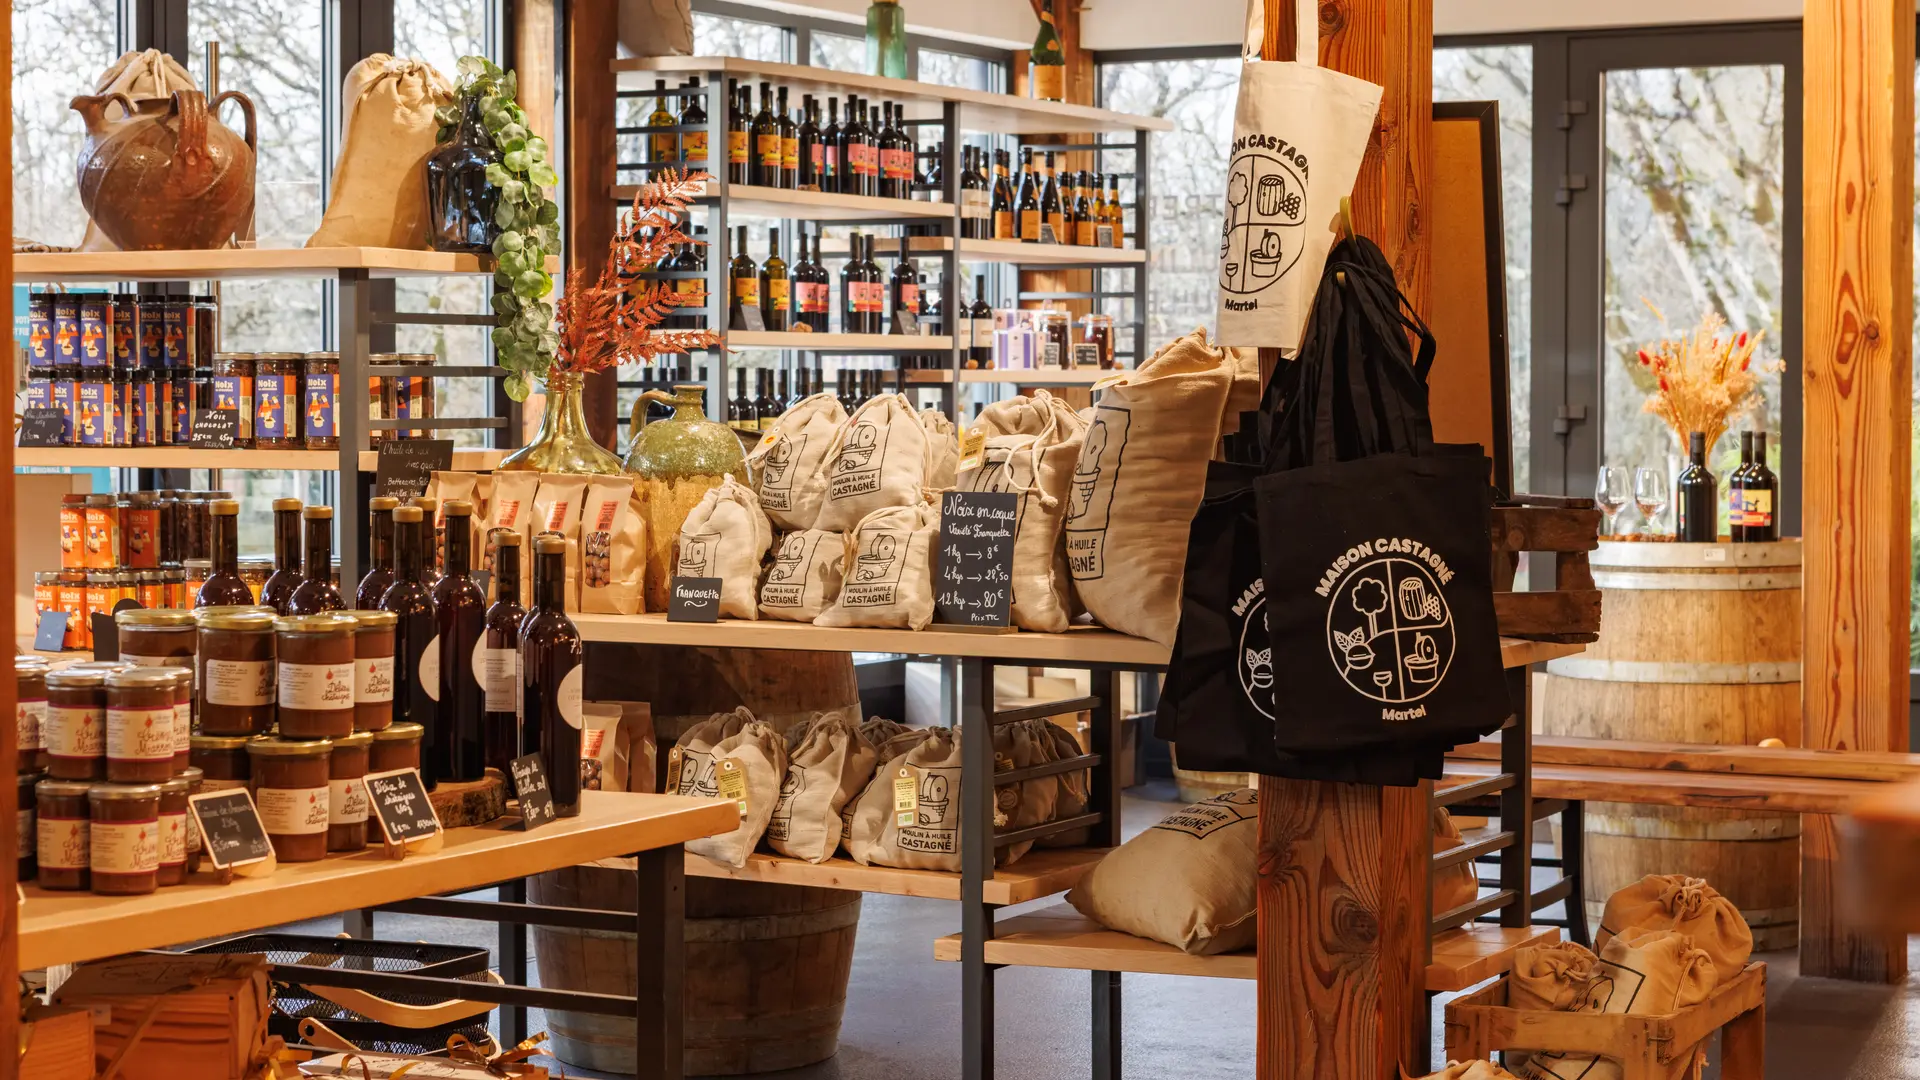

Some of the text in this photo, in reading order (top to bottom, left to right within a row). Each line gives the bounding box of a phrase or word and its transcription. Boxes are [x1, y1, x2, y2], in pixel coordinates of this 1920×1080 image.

[1225, 298, 1258, 311] Martel
[215, 380, 233, 389] Noix
[258, 380, 277, 388] Noix
[308, 378, 326, 387] Noix
[832, 477, 850, 486] MOULIN
[832, 479, 876, 496] CASTAGNÉ
[990, 508, 1016, 528] coque
[973, 524, 1011, 541] Franquette
[1075, 539, 1097, 550] HUILE
[1315, 538, 1456, 597] MAISON CASTAGNÉ
[847, 593, 891, 604] CASTAGNÉ
[1231, 578, 1264, 616] MAIS
[971, 613, 985, 621] Prix
[1382, 704, 1427, 721] Martel
[902, 828, 924, 838] MOULIN
[901, 837, 952, 850] CASTAGNÉ
